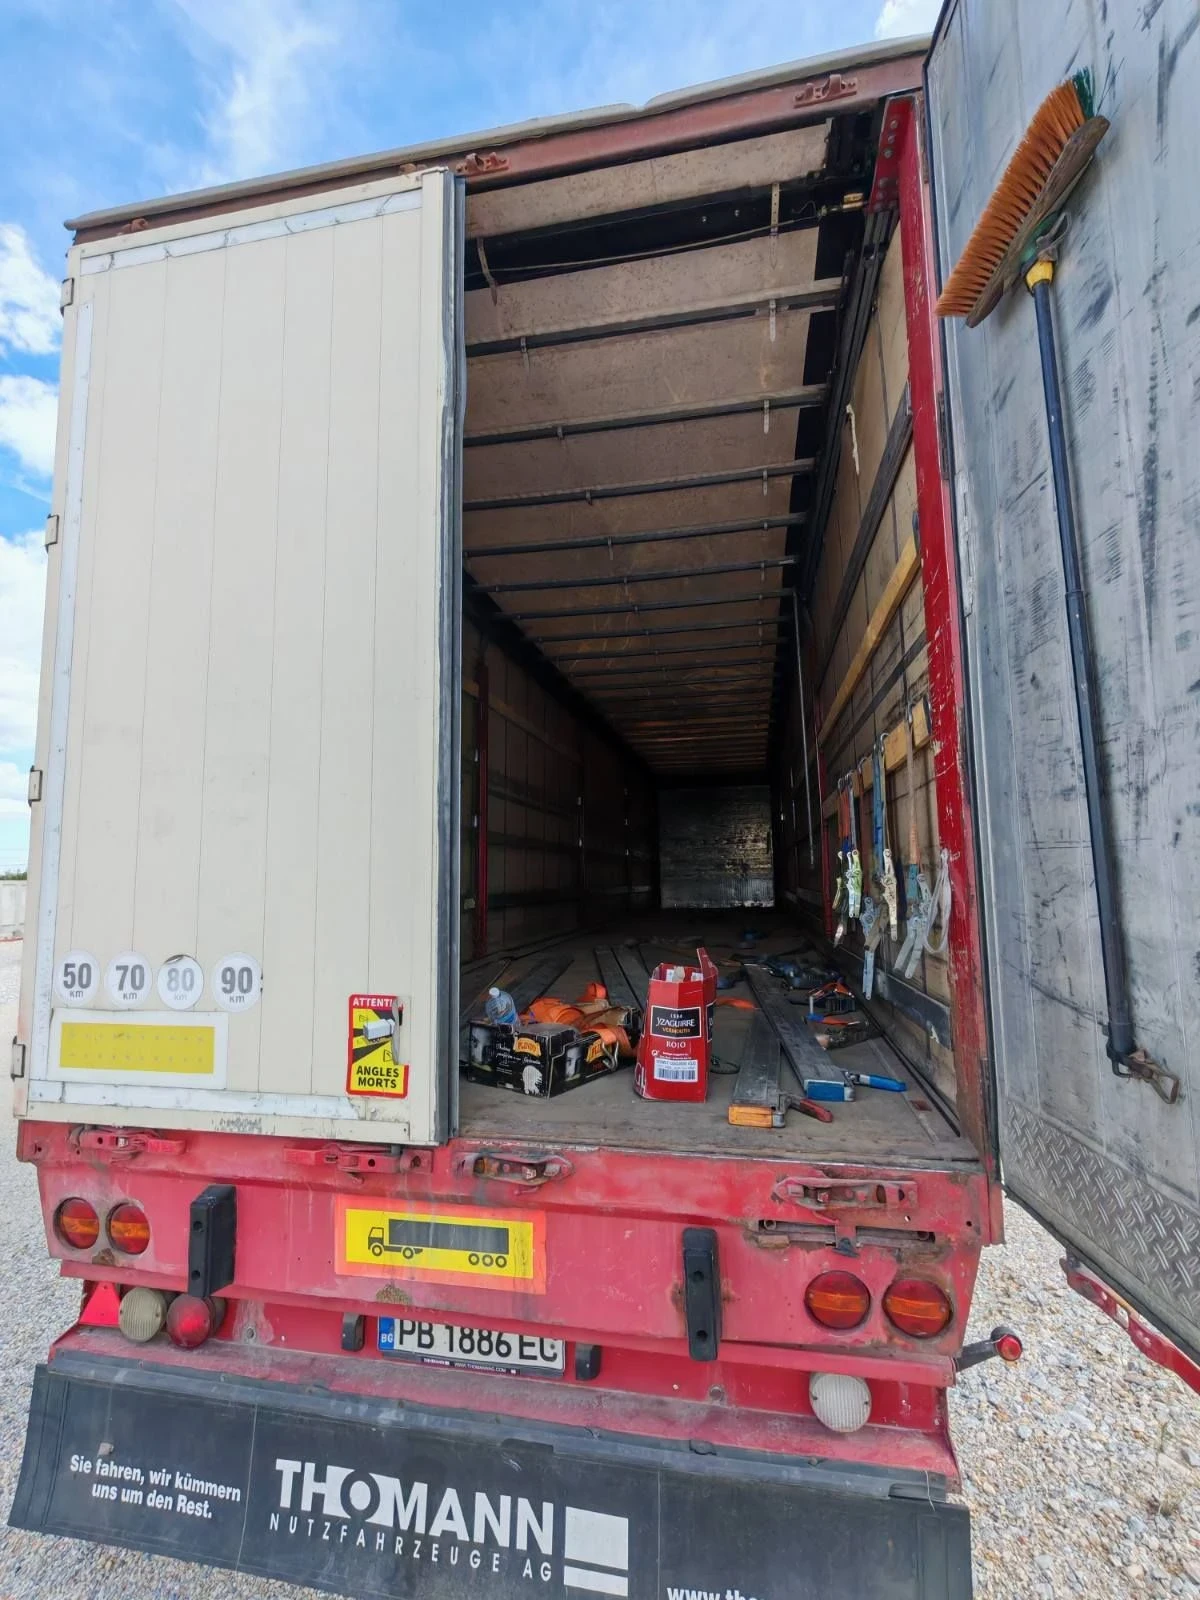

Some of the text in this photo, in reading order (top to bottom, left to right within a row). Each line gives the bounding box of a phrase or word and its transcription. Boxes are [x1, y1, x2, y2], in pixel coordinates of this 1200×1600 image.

[63, 963, 92, 989] 50
[115, 964, 145, 991] 70
[167, 967, 195, 993] 80
[221, 966, 253, 994] 90
[352, 997, 393, 1008] ATTENTI
[356, 1065, 399, 1078] ANGLES
[358, 1077, 397, 1088] MORTS
[381, 1333, 393, 1343] BG
[399, 1319, 434, 1349] PB
[445, 1325, 512, 1358] 1886
[70, 1454, 241, 1502] Sie fahren, wir kümmern
[92, 1483, 212, 1519] uns um den Rest.
[275, 1458, 554, 1555] THOMANN
[269, 1513, 552, 1582] NUTZFAHRZEUGE AG
